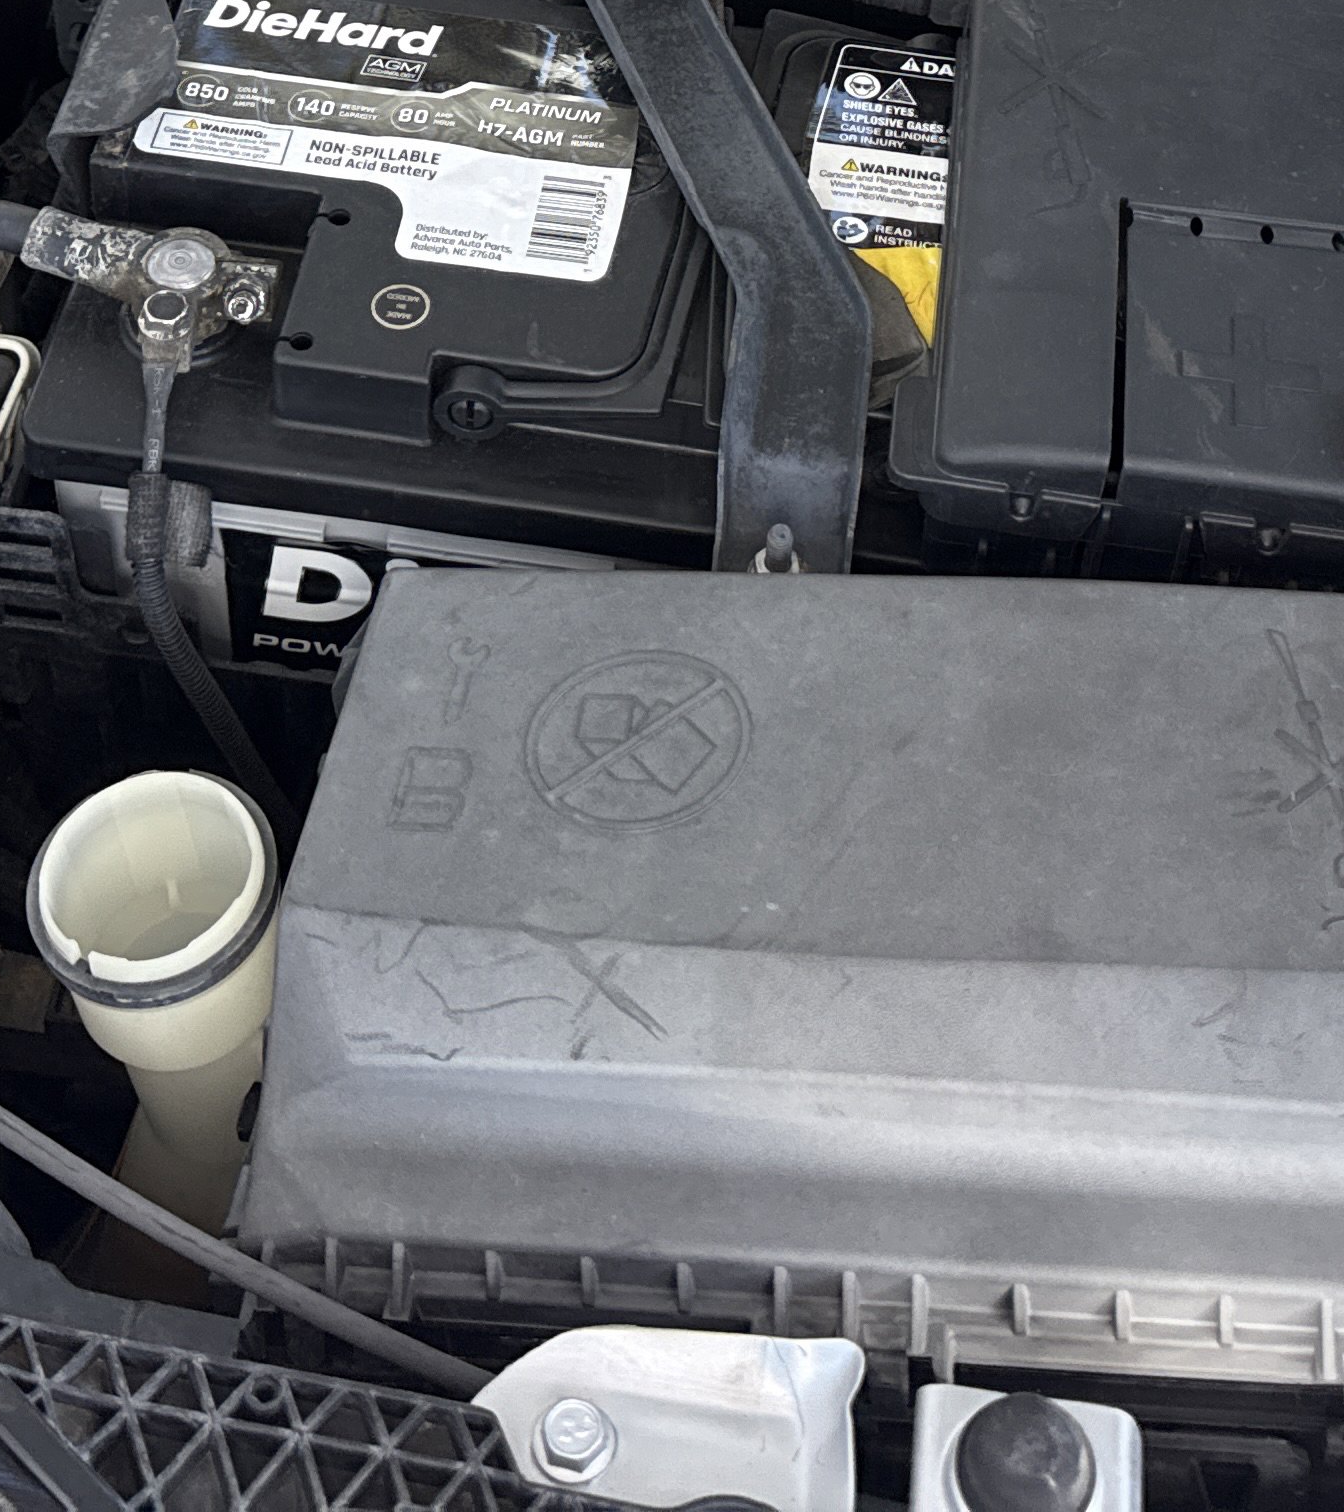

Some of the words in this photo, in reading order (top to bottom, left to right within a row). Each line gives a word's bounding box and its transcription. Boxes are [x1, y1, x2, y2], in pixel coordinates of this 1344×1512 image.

[368, 58, 422, 74] AGM
[922, 61, 955, 77] DA
[185, 82, 229, 101] 850
[297, 97, 336, 116] 140
[490, 97, 602, 124] PLATINUM
[843, 99, 883, 113] SHIELD
[885, 104, 918, 118] EYES.
[398, 108, 429, 125] 80
[841, 111, 904, 128] EXPLOSIVE
[906, 120, 944, 134] GASES
[477, 119, 564, 147] H7-AGM
[840, 123, 882, 136] CAUSE
[838, 133, 857, 143] OR
[860, 135, 907, 149] INJURY.
[309, 139, 441, 165] NON-SPILLABLE
[305, 152, 342, 167] Lead
[344, 158, 377, 171] Acid
[380, 162, 437, 181] Battery
[819, 169, 854, 180] Cancer
[855, 175, 874, 183] and
[876, 176, 937, 191] Reproductive
[830, 180, 857, 189] Wash
[859, 183, 888, 193] hands
[890, 187, 912, 197] after
[591, 190, 608, 221] 76839
[413, 232, 455, 245] Advance
[457, 238, 482, 248] Auto
[416, 223, 471, 238] Distributed
[875, 224, 913, 237] READ
[585, 225, 602, 257] 92350
[410, 241, 450, 255] Raleigh,
[452, 246, 468, 256] NC
[469, 249, 502, 261] 27604
